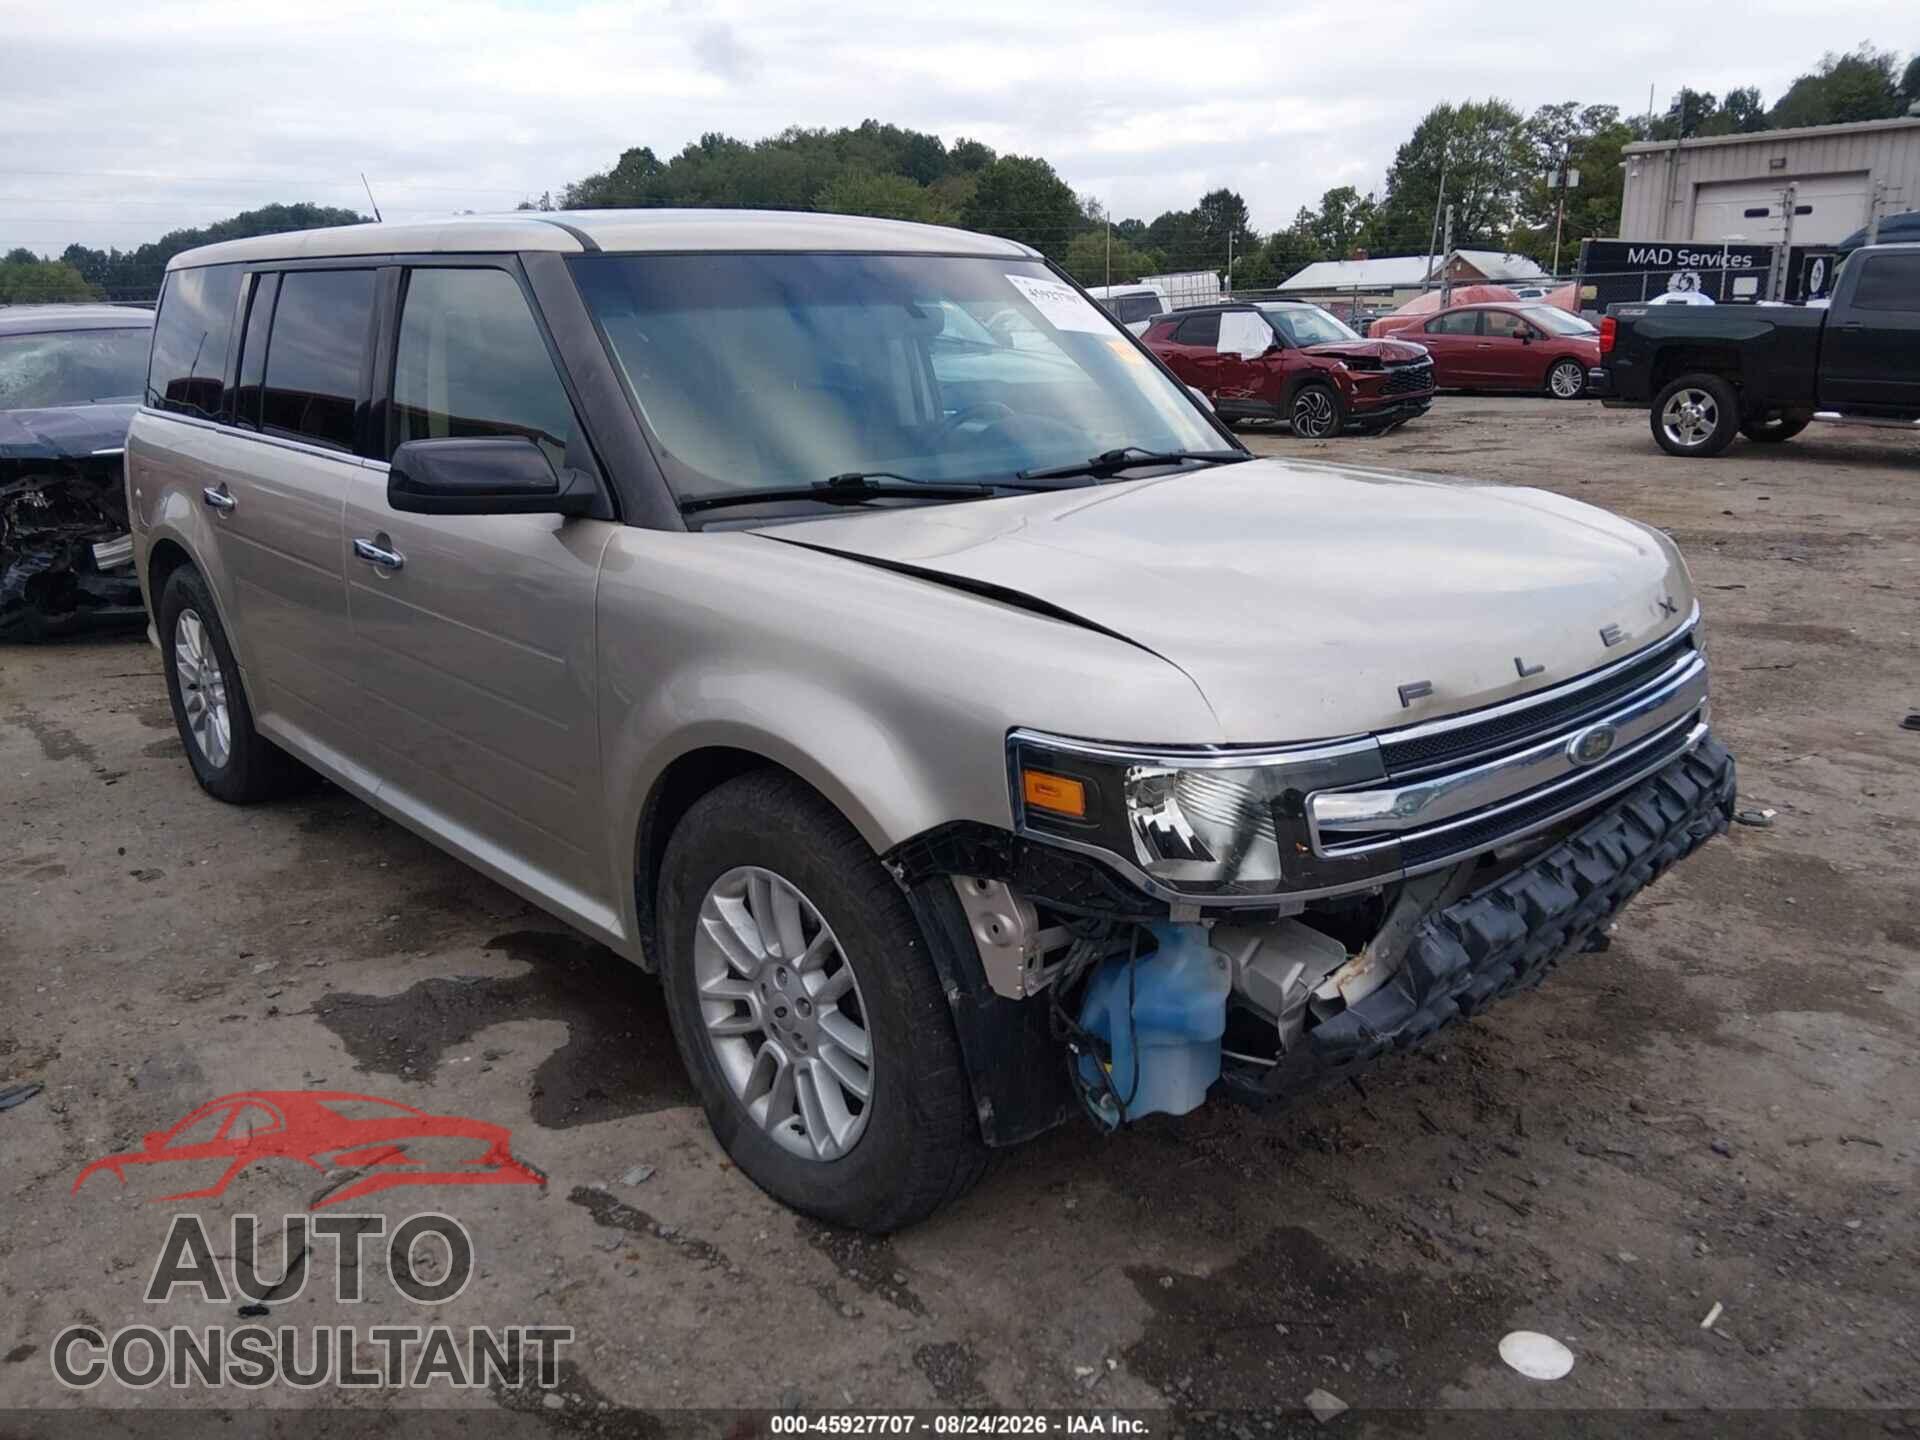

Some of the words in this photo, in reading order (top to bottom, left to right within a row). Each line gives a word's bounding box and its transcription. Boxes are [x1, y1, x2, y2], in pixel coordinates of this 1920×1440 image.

[1627, 247, 1673, 265] MAD
[1677, 249, 1752, 268] Services
[1398, 597, 1677, 707] FLEX
